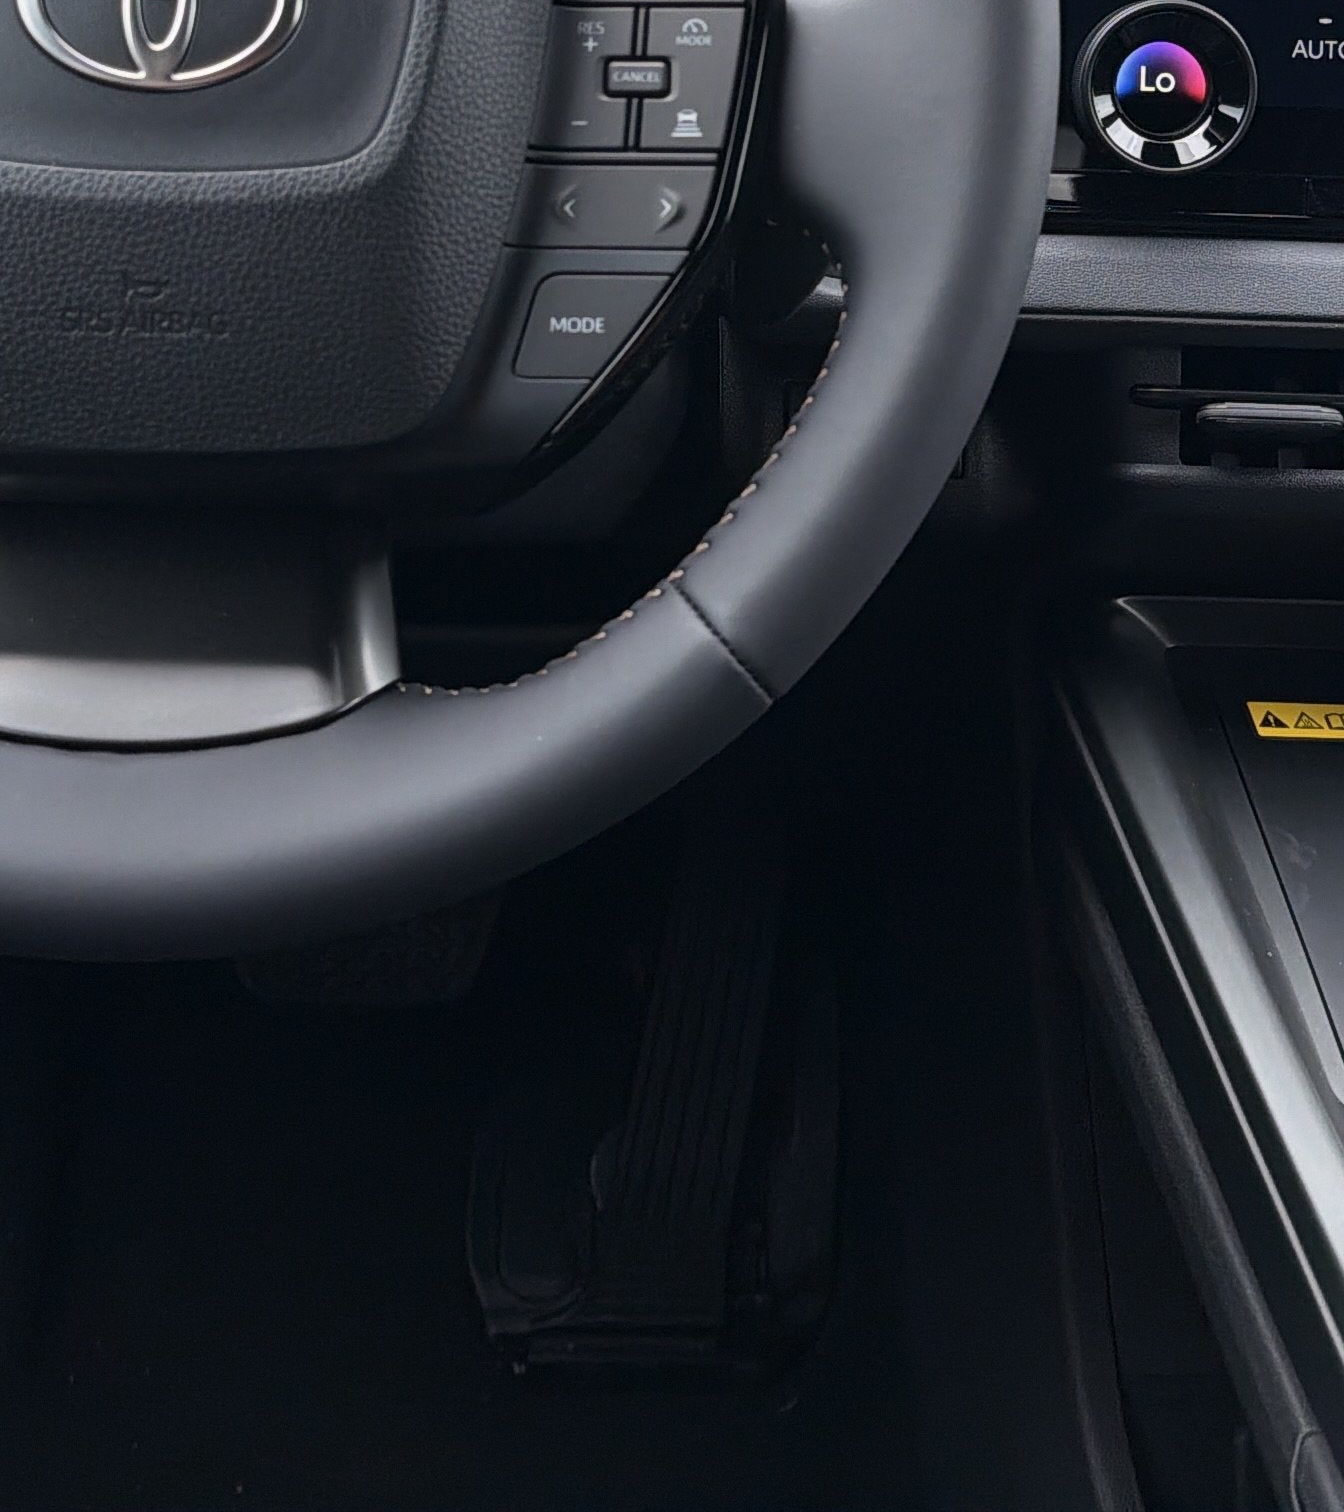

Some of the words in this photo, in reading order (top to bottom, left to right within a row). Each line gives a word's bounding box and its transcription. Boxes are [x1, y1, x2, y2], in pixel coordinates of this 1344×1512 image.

[577, 21, 606, 35] RES
[612, 70, 661, 83] CANCEL
[1139, 65, 1176, 93] Lo
[549, 316, 606, 335] MODE
